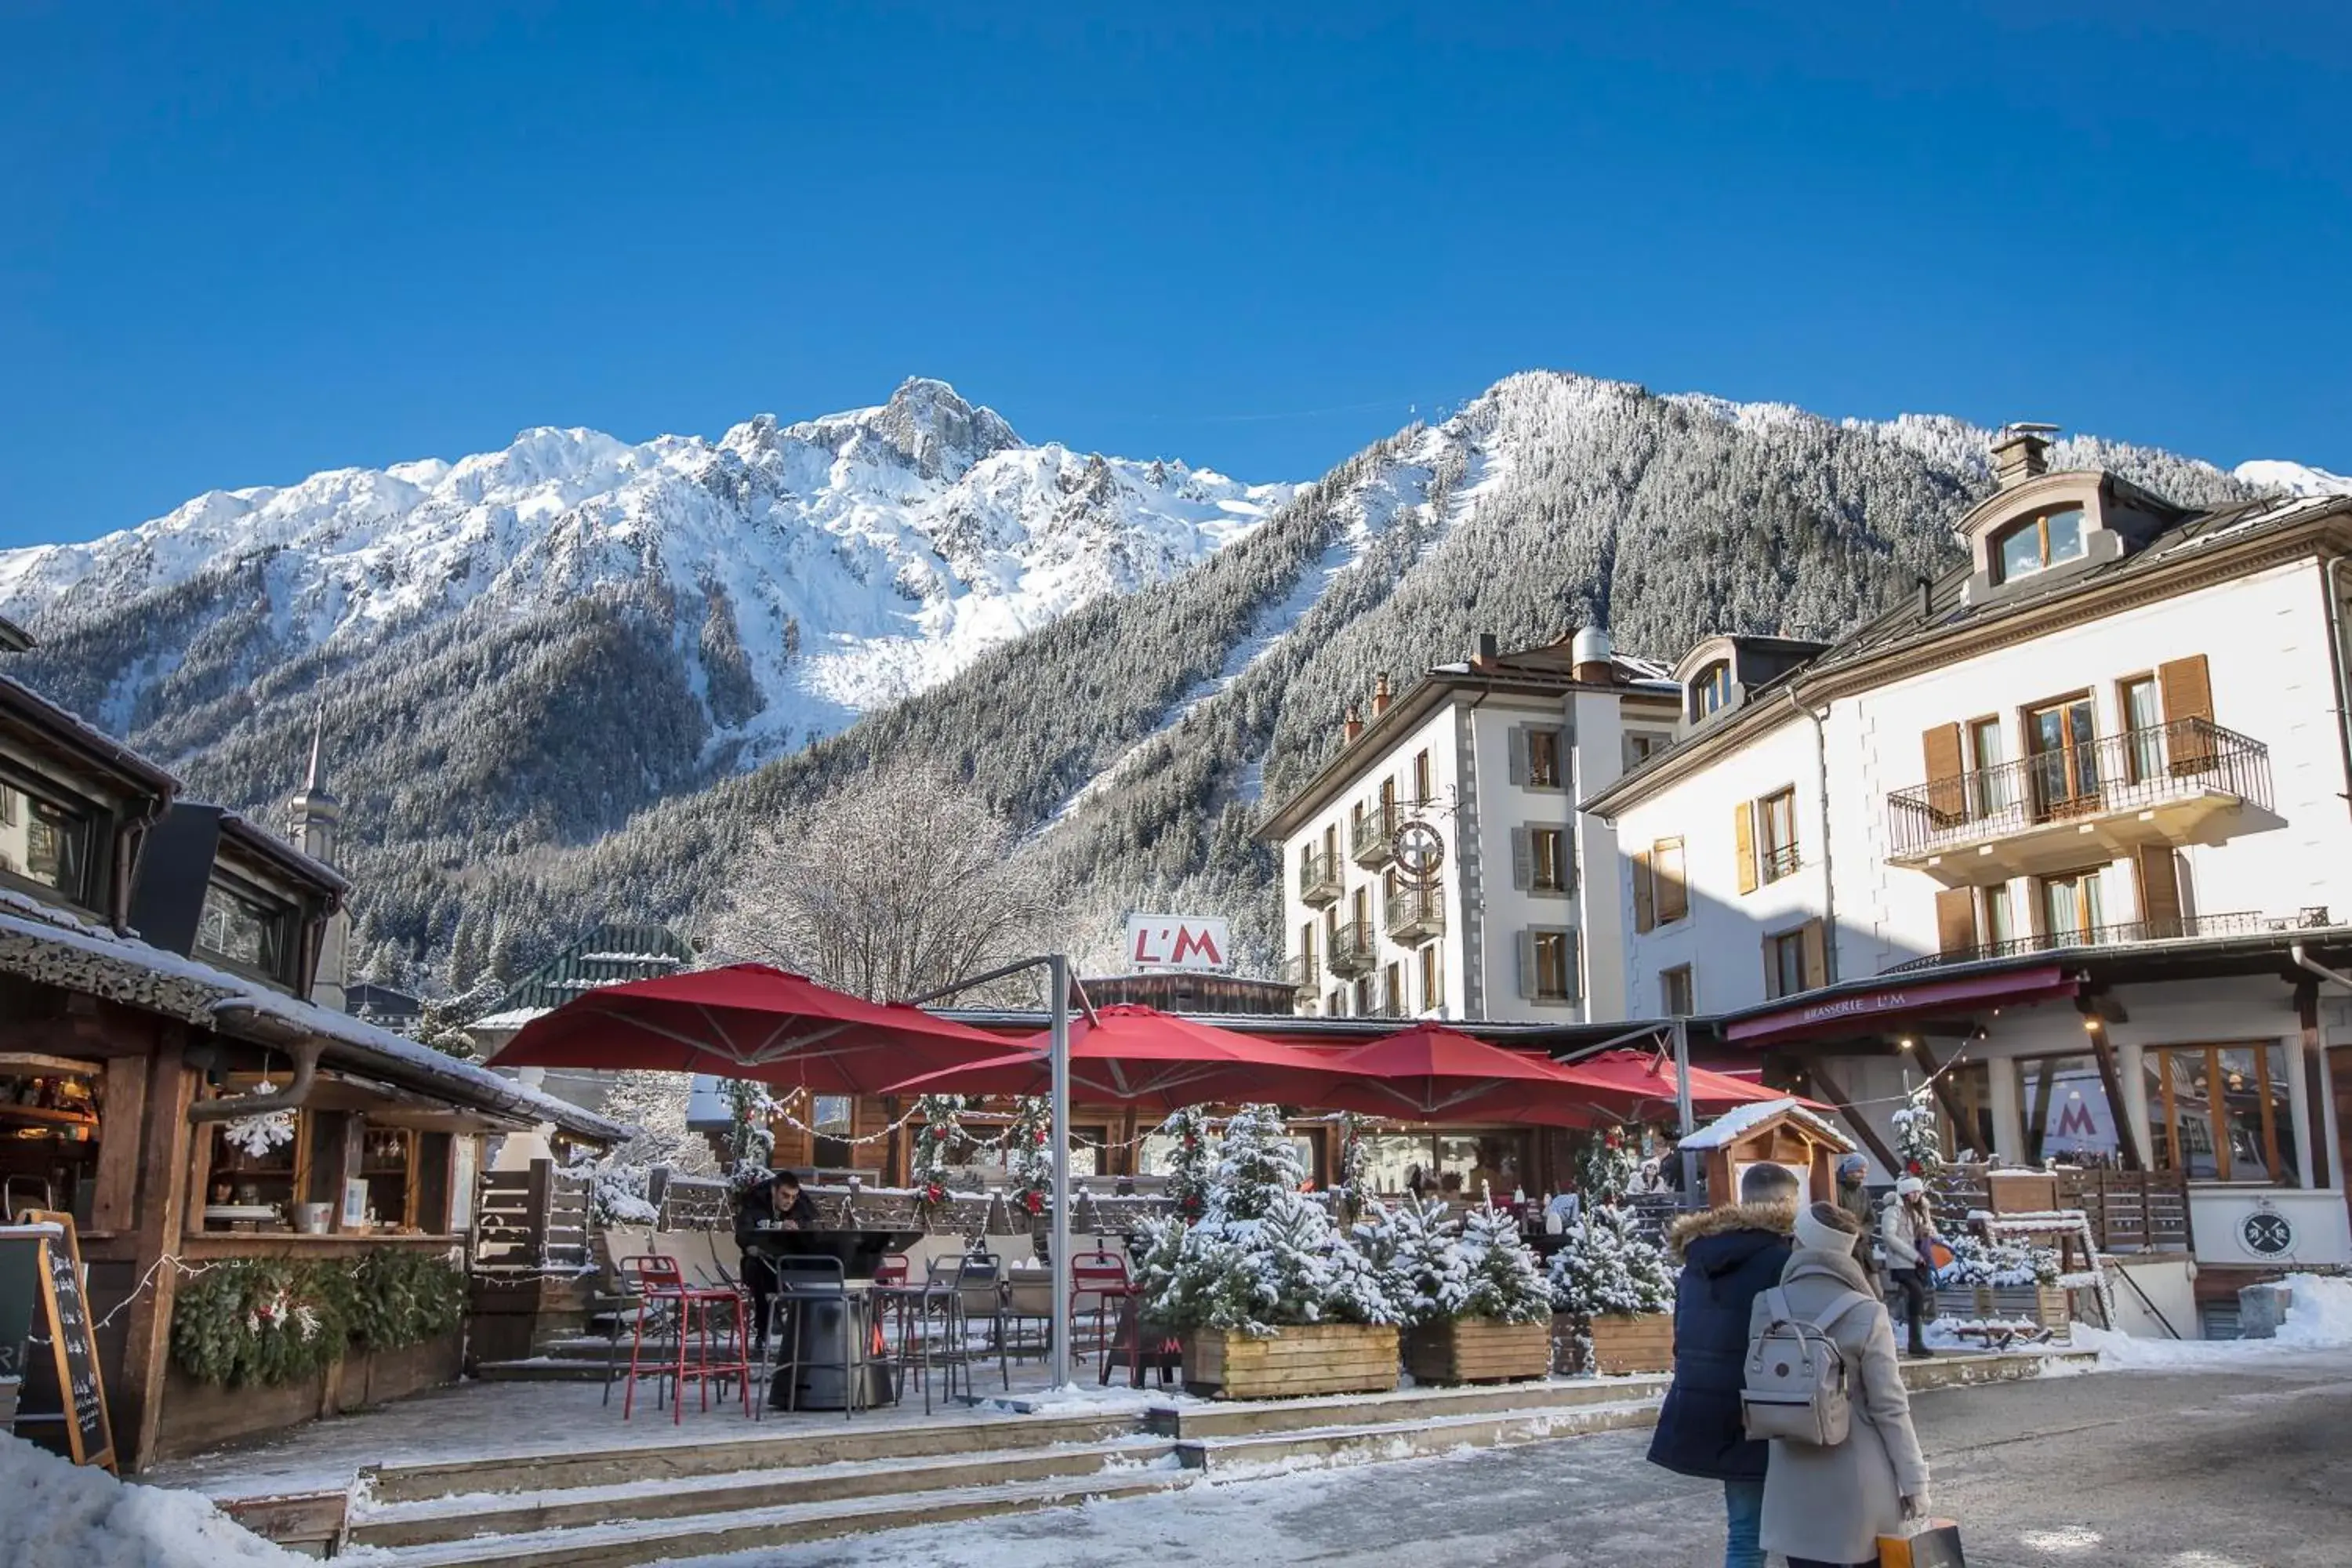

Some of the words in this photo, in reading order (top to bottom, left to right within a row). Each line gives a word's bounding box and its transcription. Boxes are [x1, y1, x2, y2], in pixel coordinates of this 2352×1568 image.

[1135, 924, 1222, 964] L'M
[1804, 999, 1864, 1019] BRASSERIE
[1877, 993, 1906, 1007] L'M
